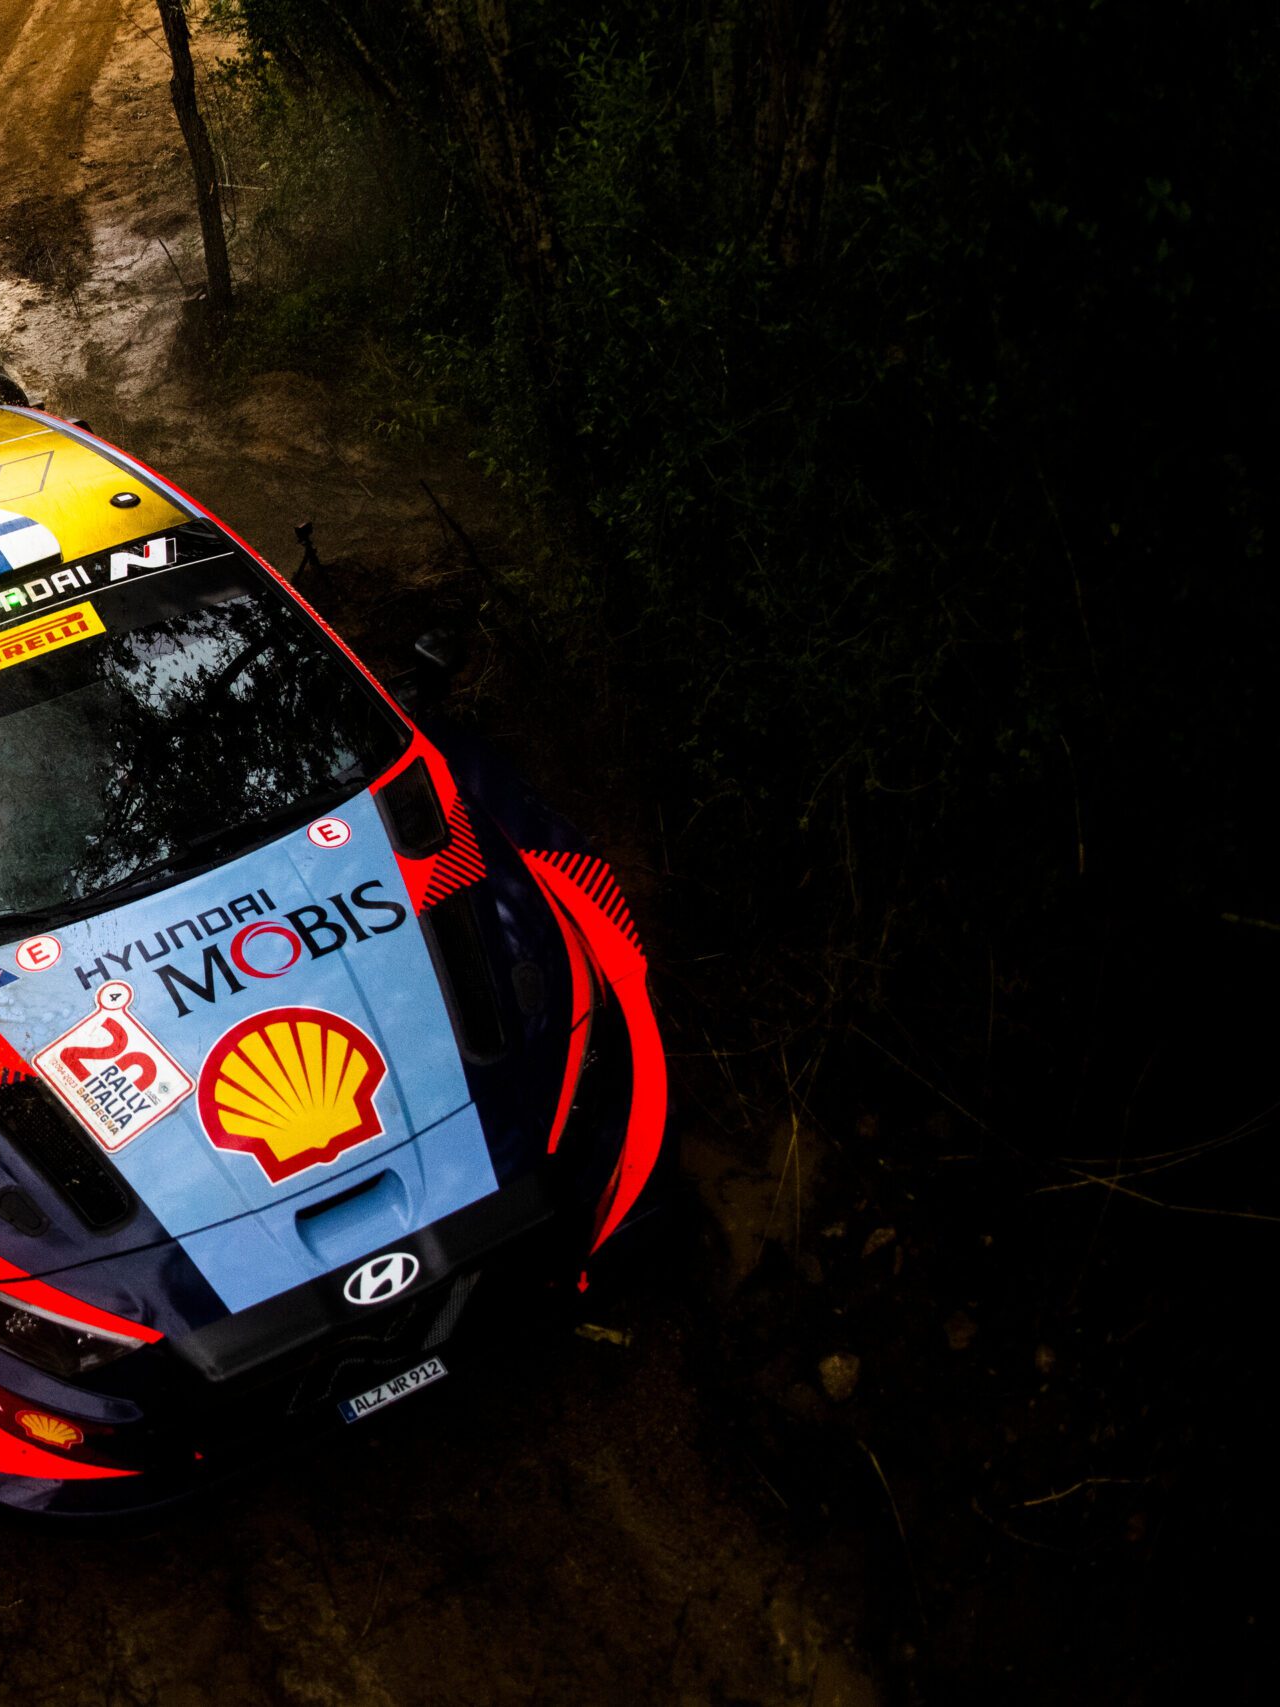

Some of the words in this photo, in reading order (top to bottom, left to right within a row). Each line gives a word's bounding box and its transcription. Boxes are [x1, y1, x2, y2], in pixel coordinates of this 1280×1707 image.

[317, 823, 341, 842] E
[26, 942, 51, 965] E
[74, 888, 278, 990] HYUNDAI
[153, 878, 407, 1018] MOBIS
[108, 992, 123, 1003] 4
[76, 1086, 120, 1137] SARDEGNA
[84, 1075, 135, 1130] ITALIA
[100, 1064, 152, 1114] RALLY
[354, 1388, 387, 1414] ALZ
[386, 1375, 412, 1396] WR
[409, 1361, 442, 1385] 912
